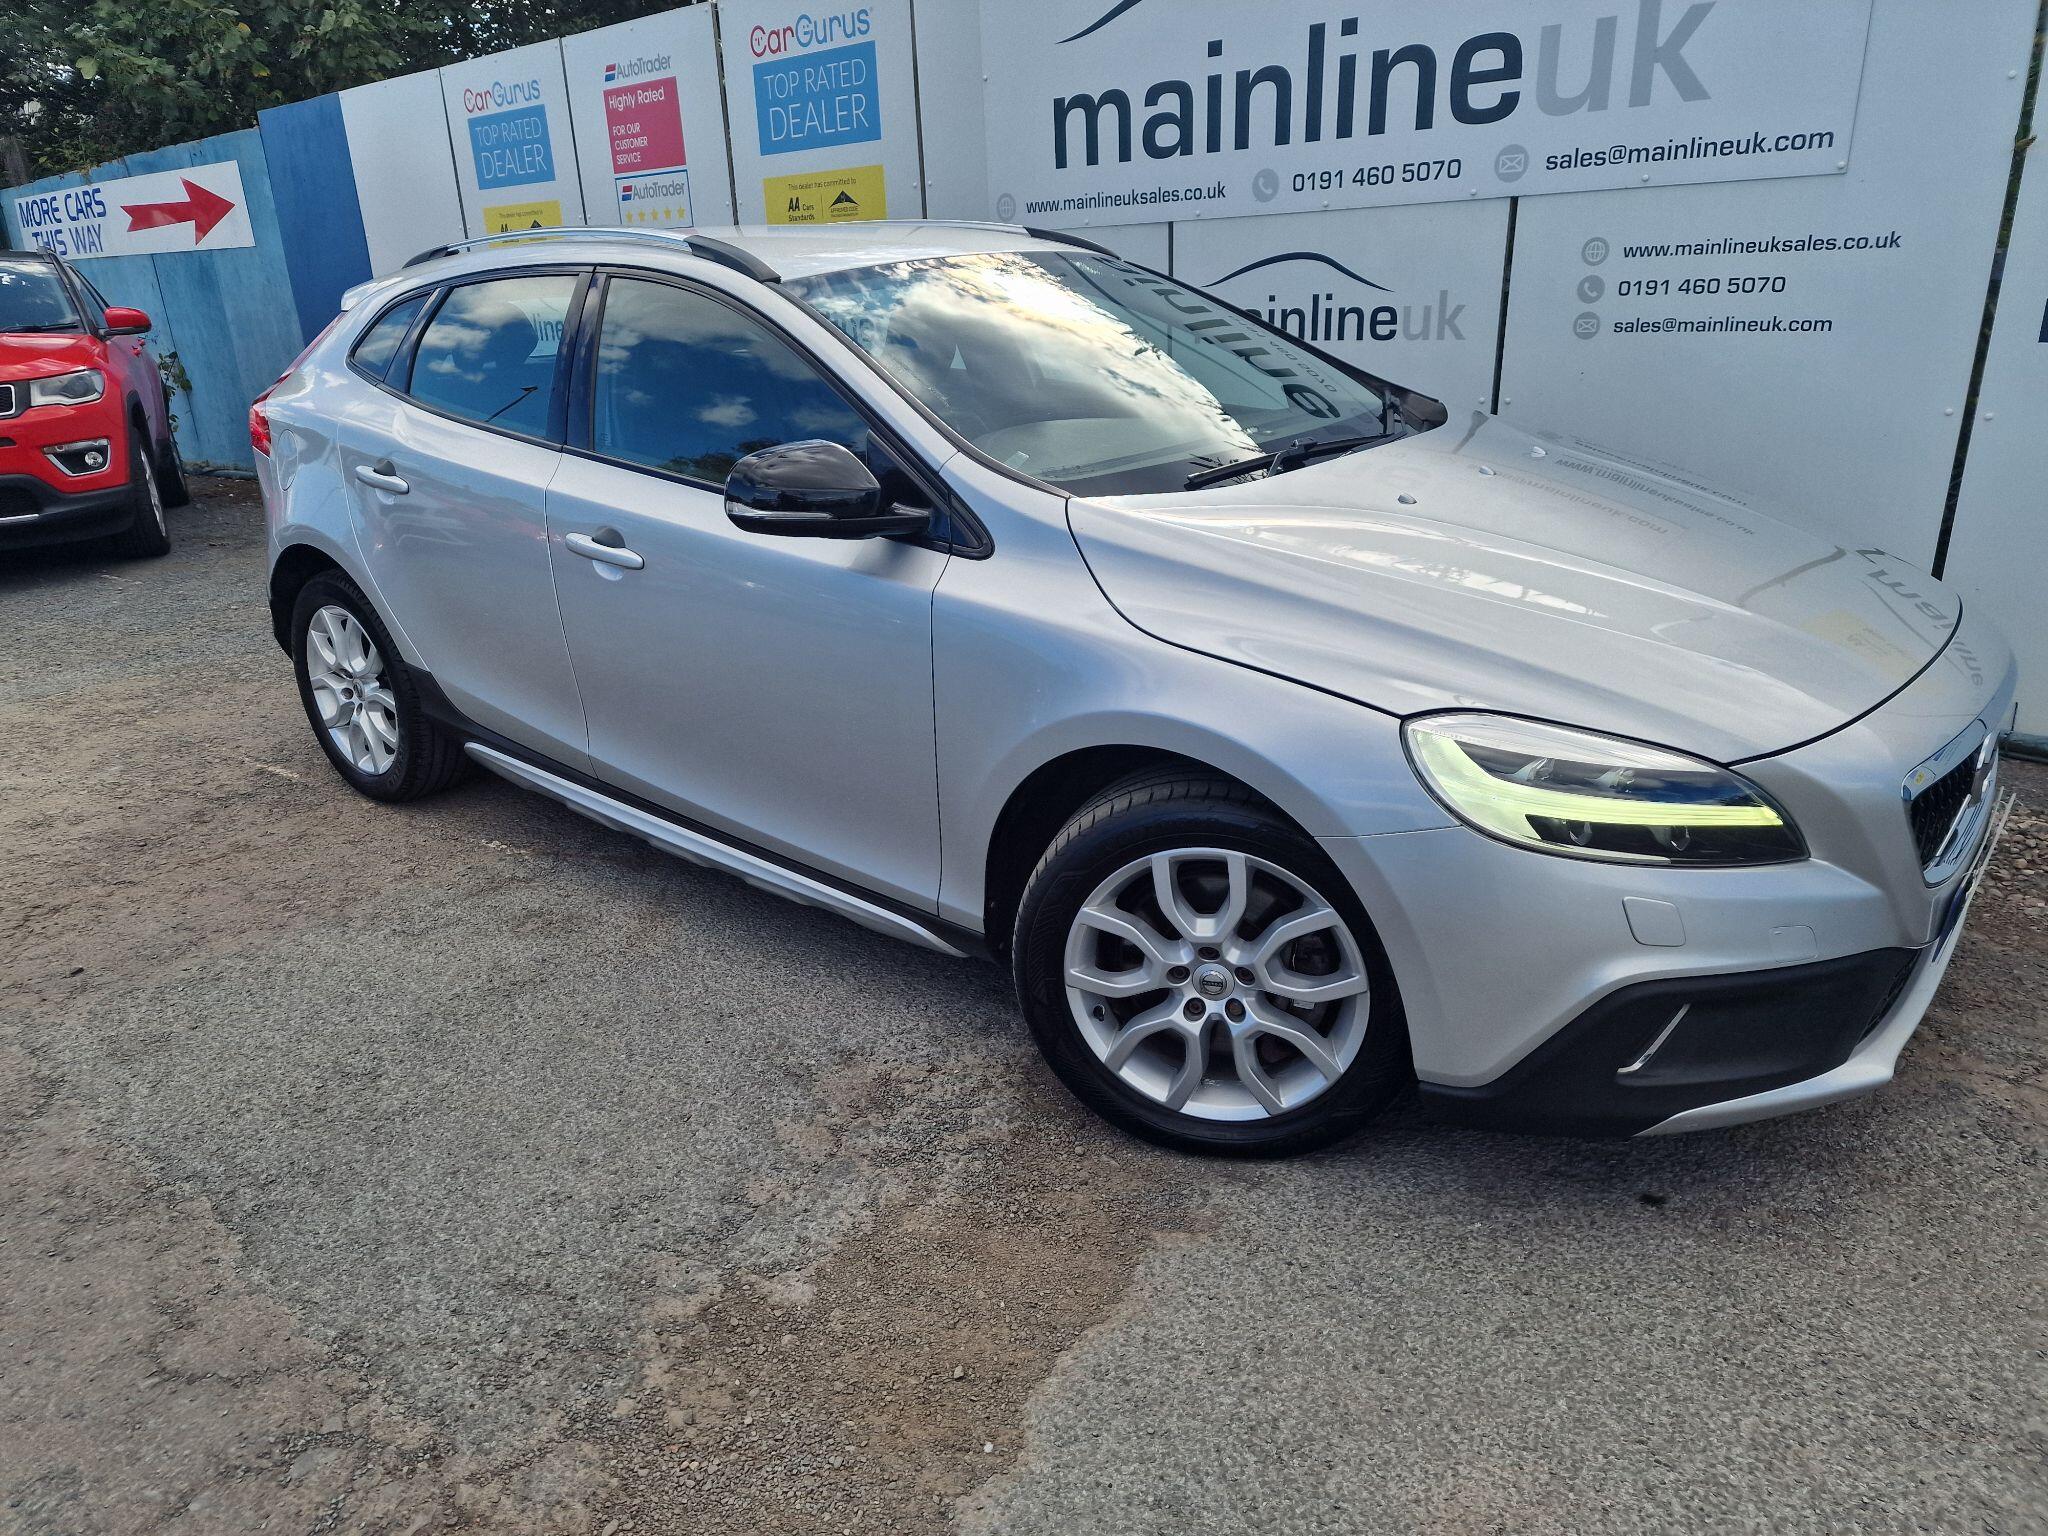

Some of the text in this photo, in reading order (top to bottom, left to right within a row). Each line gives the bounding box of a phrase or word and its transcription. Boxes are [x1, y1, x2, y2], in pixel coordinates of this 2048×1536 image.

[750, 8, 871, 58] CarGurus
[616, 54, 672, 80] AutoTrader
[763, 58, 867, 101] TOP RATED
[463, 79, 541, 114] CarGurus
[608, 86, 665, 112] Highly Rated
[1053, 0, 1717, 169] mainlineuk
[475, 117, 542, 147] TOP RATED
[612, 122, 641, 137] FOR OUR
[769, 93, 869, 141] DEALER
[614, 136, 649, 151] CUSTOMER
[616, 151, 642, 165] SERVICE
[1545, 130, 1835, 171] sales@mainlineuk.com
[481, 143, 548, 180] DEALER
[1292, 158, 1462, 193] 0191 460 5070
[632, 180, 686, 201] AutoTrader
[788, 196, 801, 212] AA
[1025, 180, 1227, 215] www.mainlineuksales.co.uk
[18, 187, 107, 228] MORE CARS
[32, 224, 104, 256] THIS WAY
[1622, 231, 1903, 258] www.mainlineuksales.co.uk
[1617, 275, 1787, 297] 0191 460 5070
[1613, 315, 1833, 333] sales@mainlineuk.com
